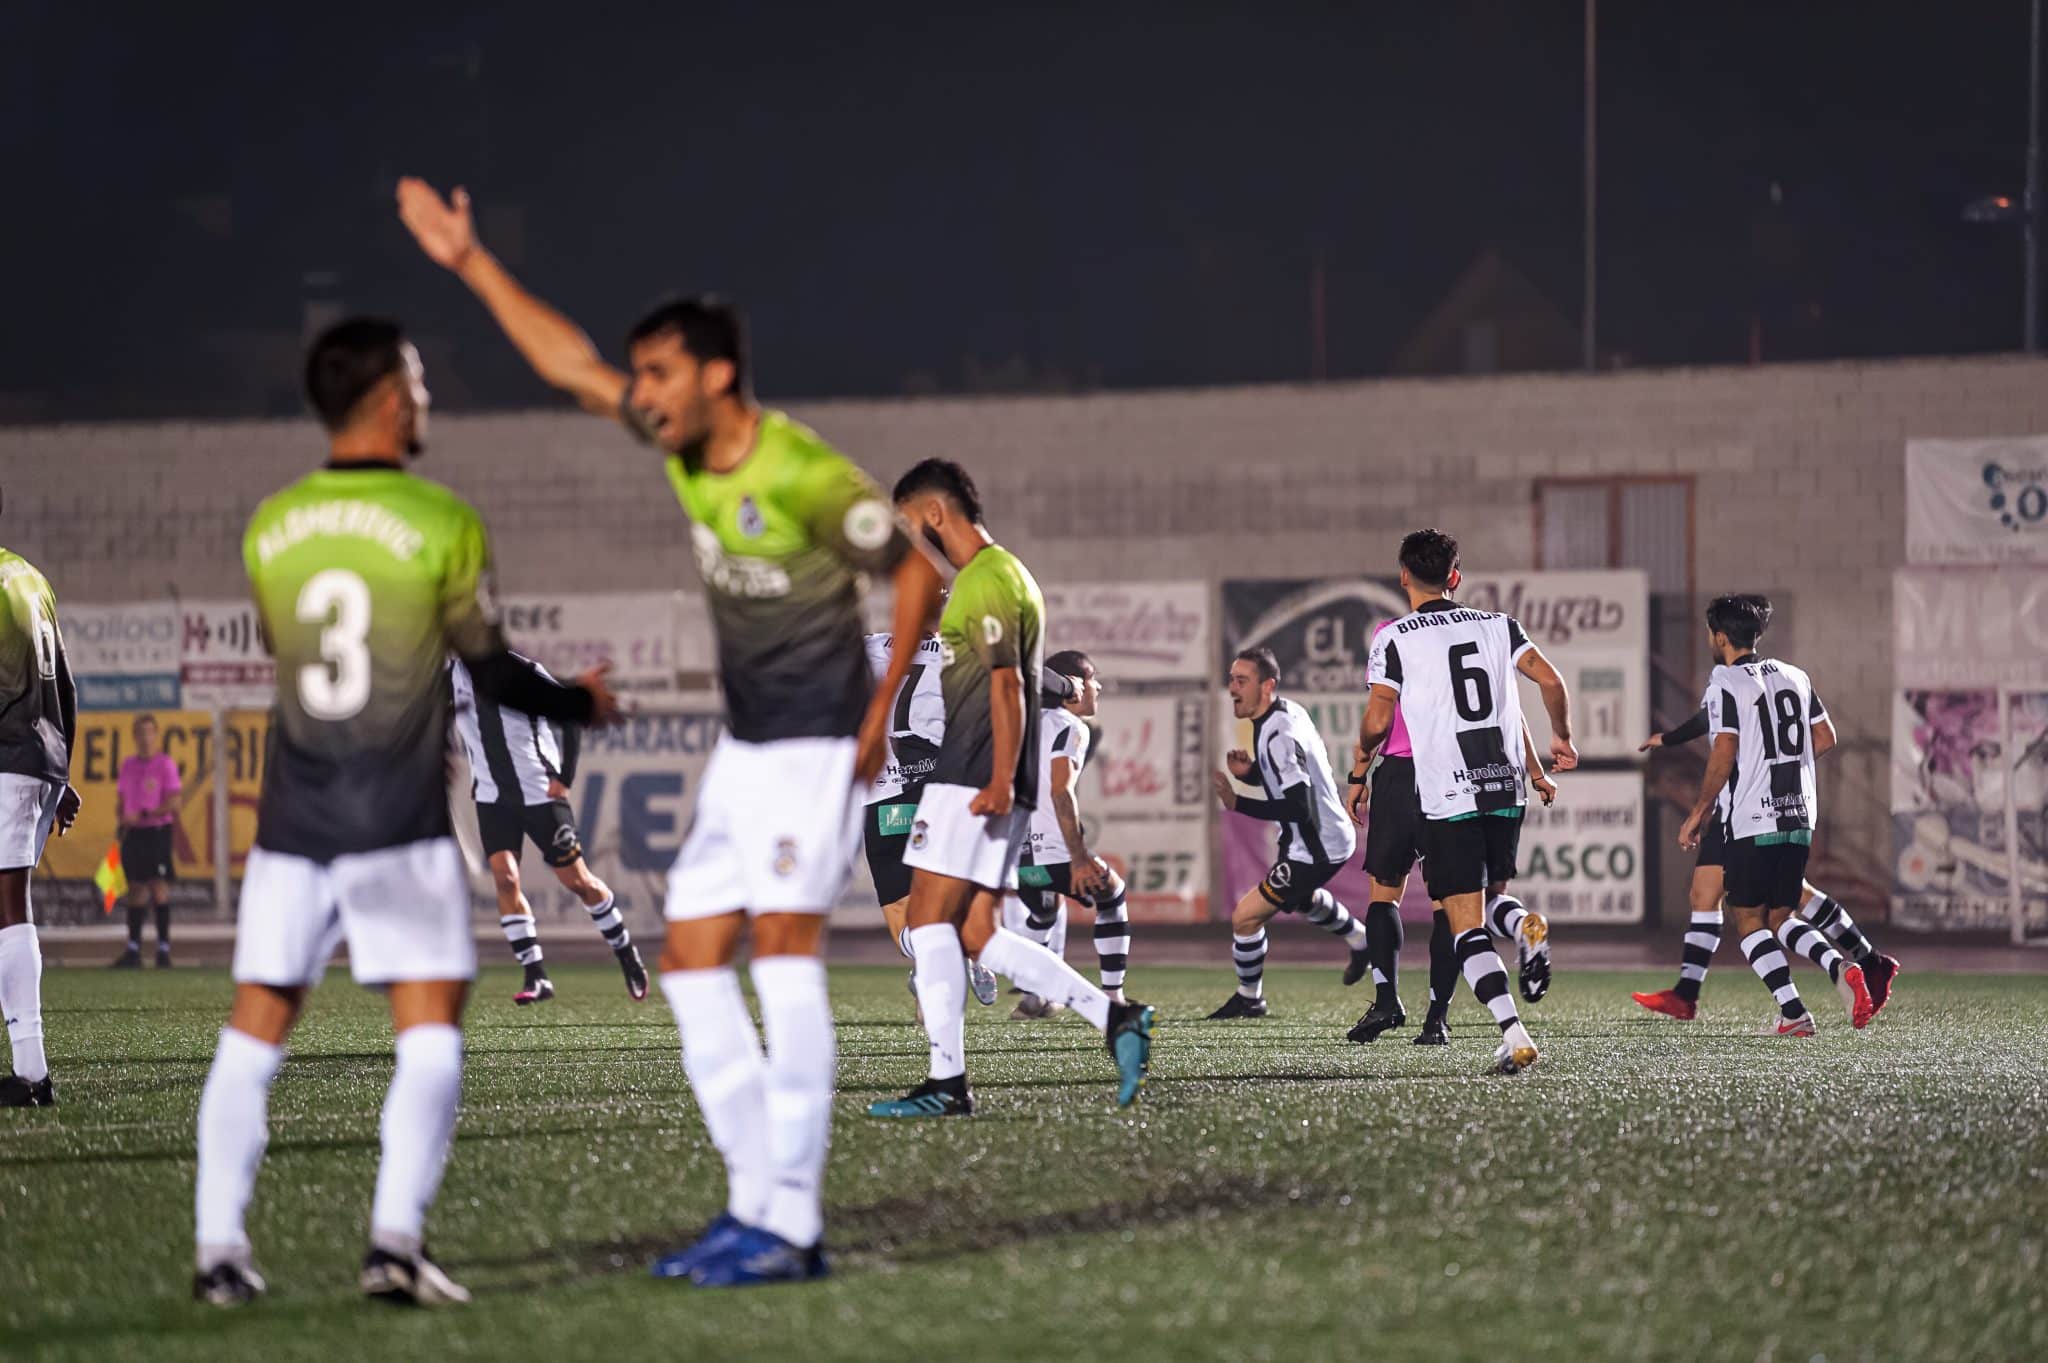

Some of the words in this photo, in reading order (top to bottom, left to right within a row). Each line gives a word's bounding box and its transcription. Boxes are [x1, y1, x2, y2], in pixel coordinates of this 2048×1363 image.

[296, 567, 372, 721] 3
[1397, 610, 1450, 634] BORJA
[893, 663, 926, 732] 7
[1448, 640, 1494, 722] 6
[84, 724, 259, 784] ELCTRI
[1753, 689, 1805, 760] 18
